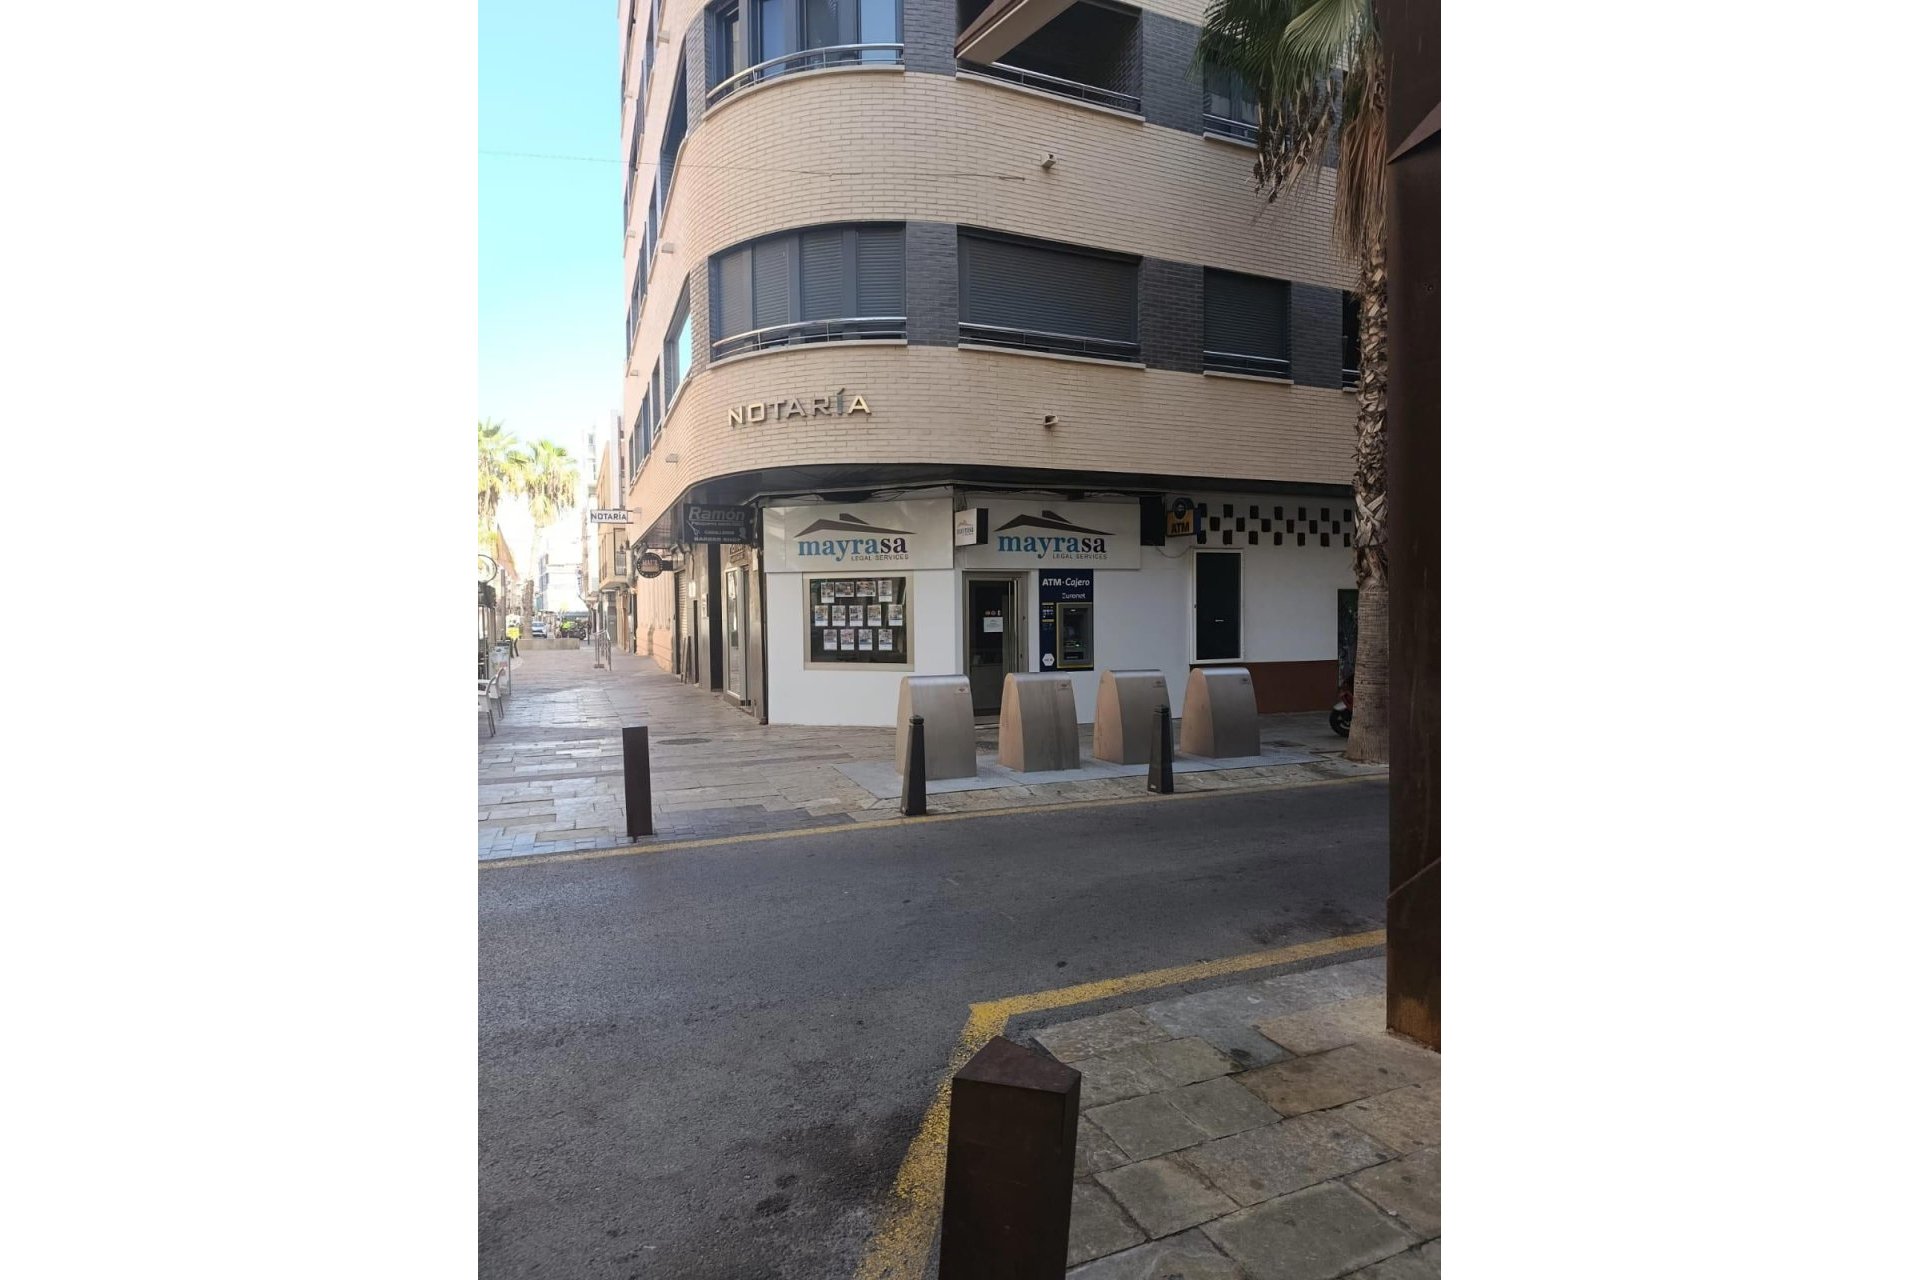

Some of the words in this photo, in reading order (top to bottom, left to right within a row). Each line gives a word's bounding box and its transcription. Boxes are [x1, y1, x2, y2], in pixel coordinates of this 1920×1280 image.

[728, 388, 872, 427] NOTARÍA
[591, 511, 627, 520] NOTARÍA
[689, 506, 745, 520] Ramón
[1171, 523, 1190, 534] ATM
[798, 537, 908, 562] mayrasa
[997, 535, 1107, 560] mayrasa
